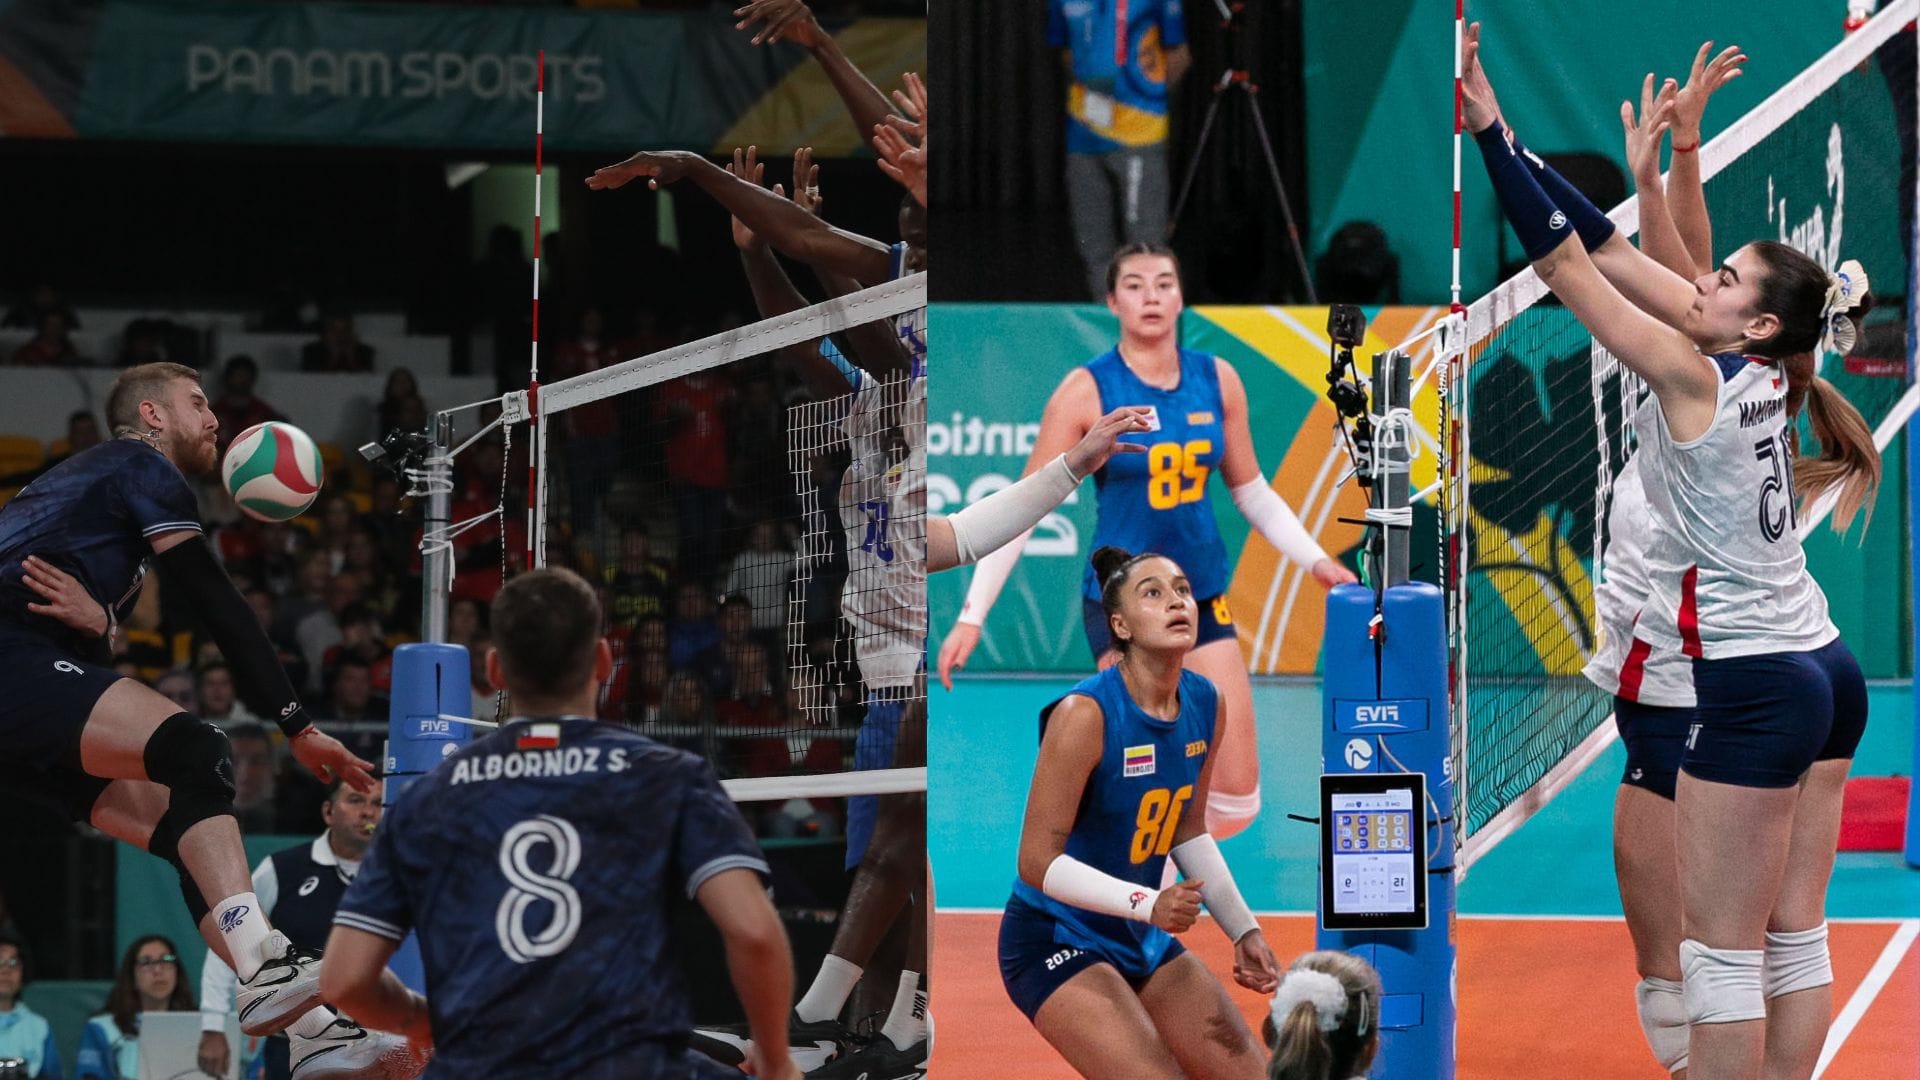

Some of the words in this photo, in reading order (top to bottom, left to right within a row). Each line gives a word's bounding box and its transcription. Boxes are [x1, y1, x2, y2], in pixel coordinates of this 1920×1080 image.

[401, 52, 607, 103] SPORTS
[452, 747, 599, 785] ALBORNOZ
[496, 814, 582, 964] 8
[911, 993, 928, 1021] NIKE
